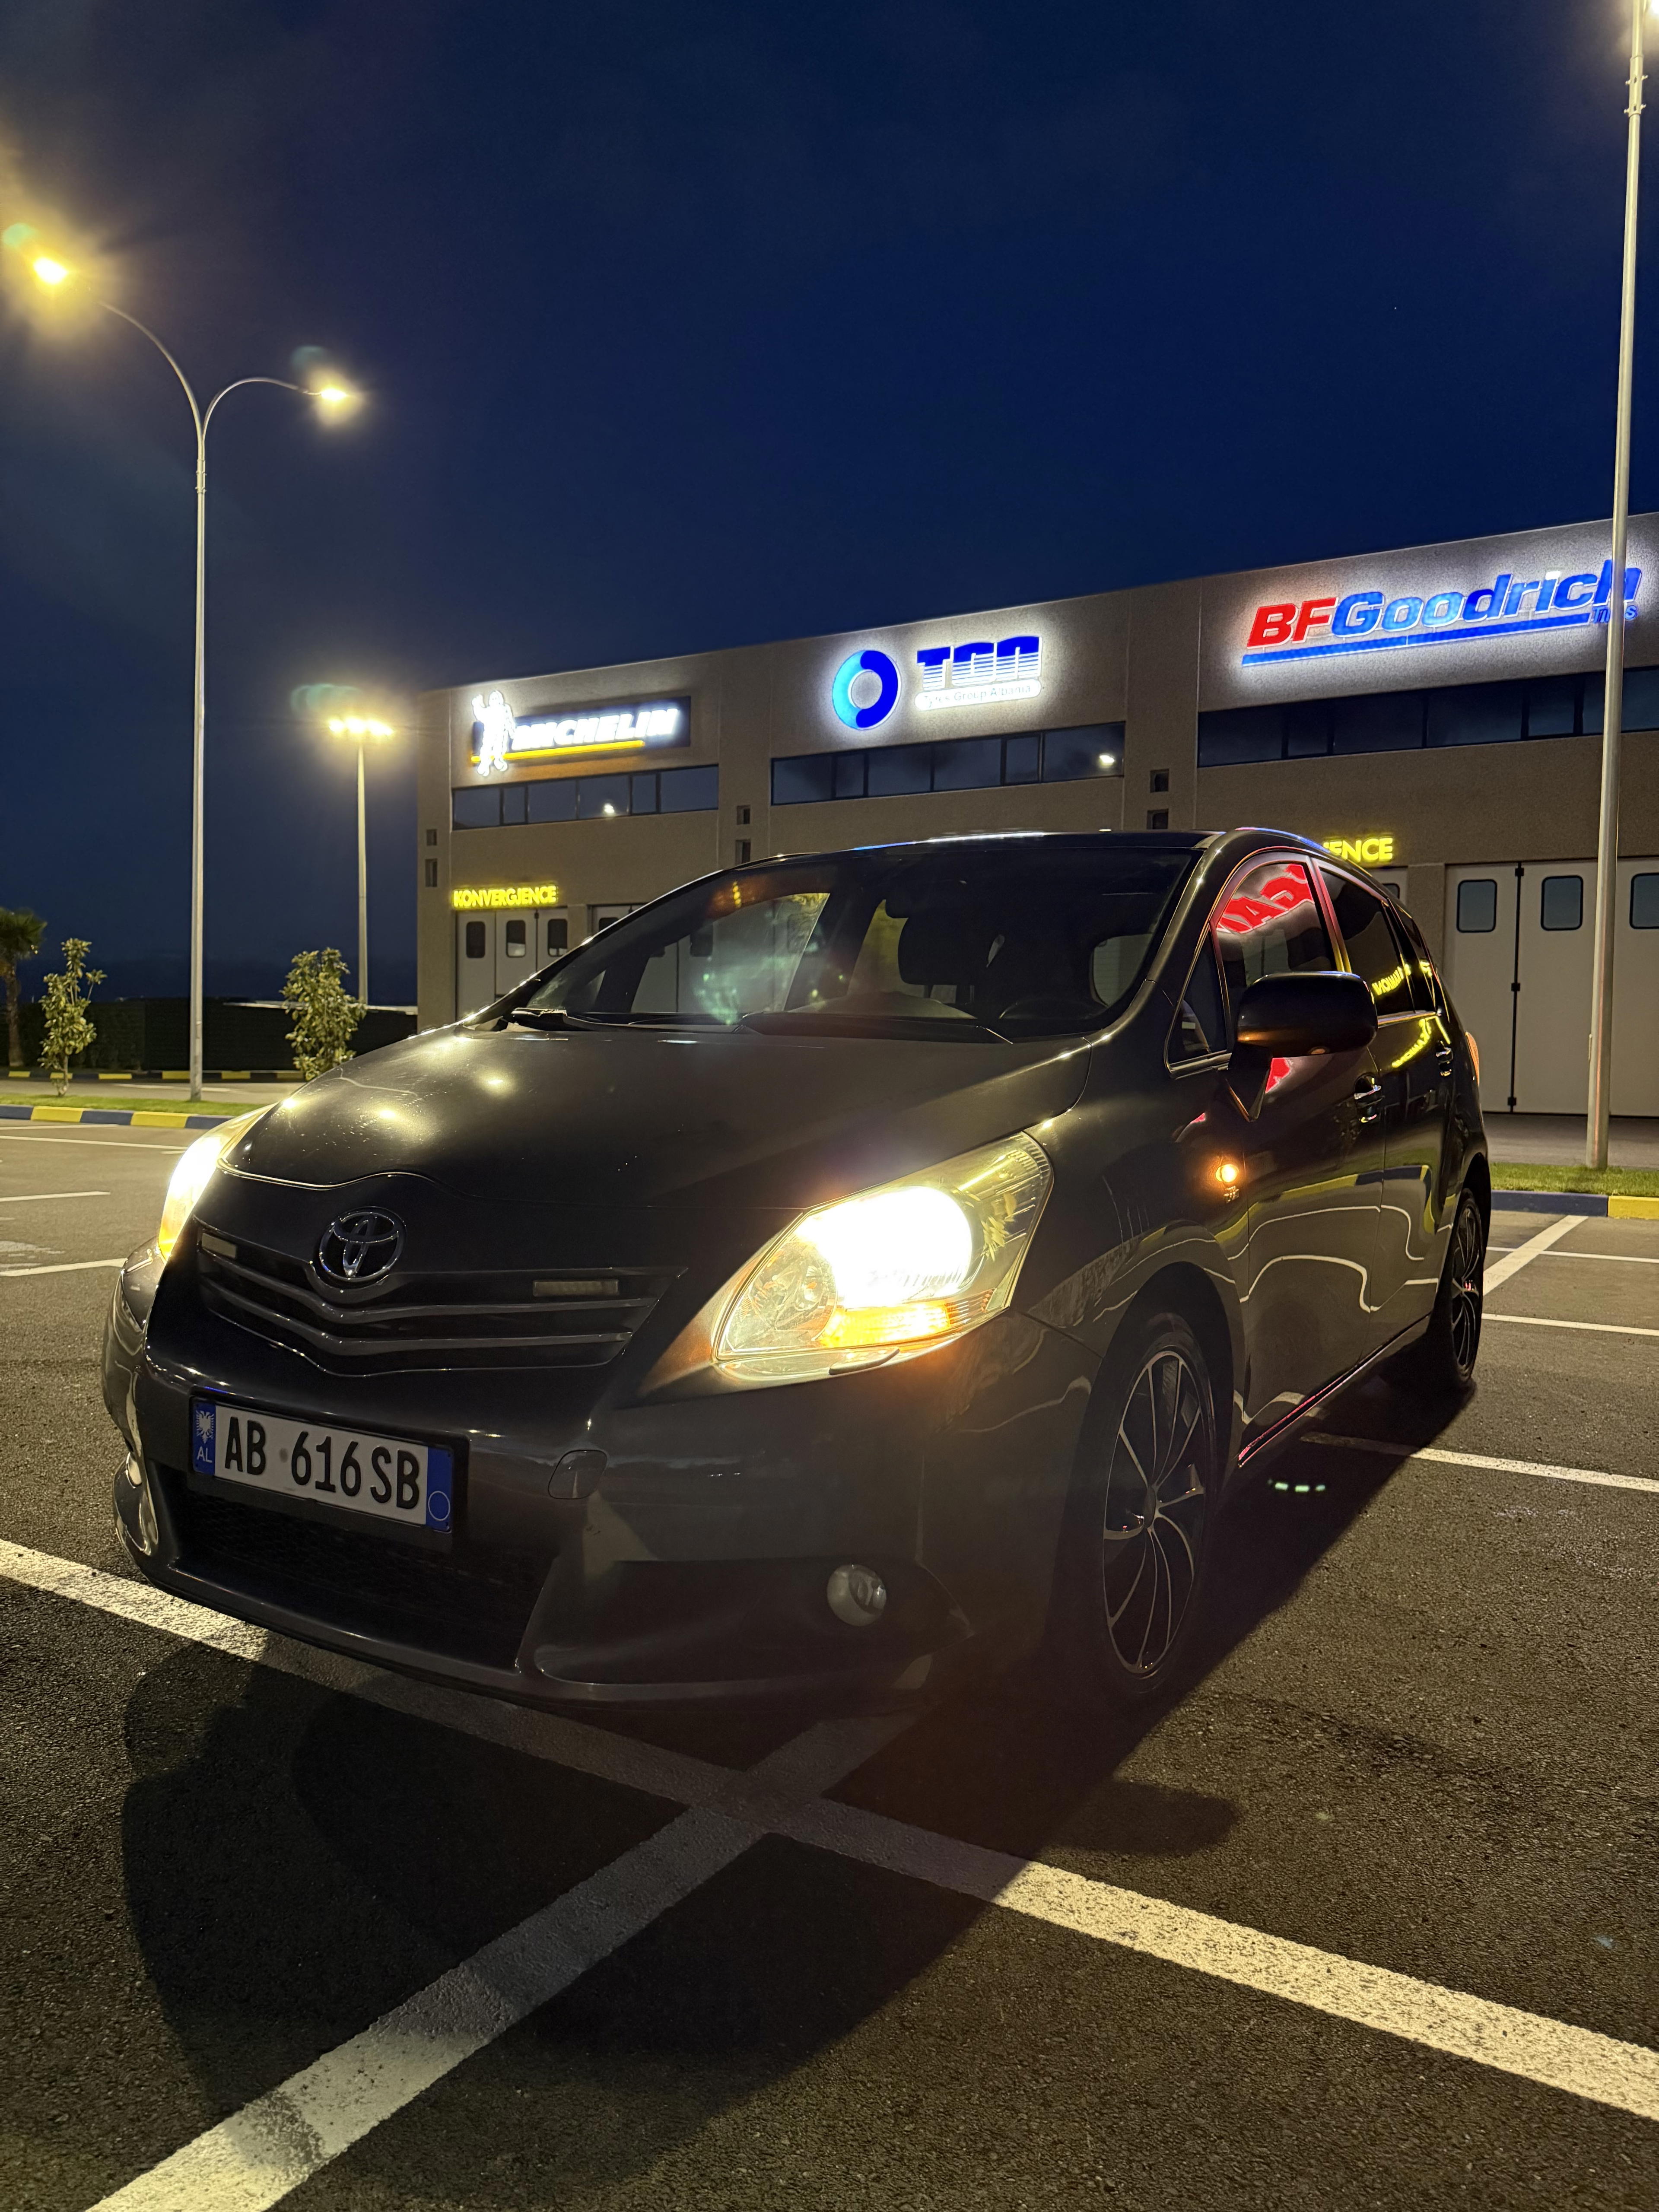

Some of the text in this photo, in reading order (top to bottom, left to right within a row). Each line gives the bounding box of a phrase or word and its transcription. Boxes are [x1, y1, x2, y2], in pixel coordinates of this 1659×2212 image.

[1246, 559, 1642, 648] BFGoodrich
[1592, 605, 1638, 623] Tis
[953, 691, 987, 702] Group
[990, 686, 1031, 697] Albania
[511, 708, 679, 750] MICHELIN
[1323, 837, 1393, 863] ENCE
[453, 885, 557, 907] KONVERGJENCE
[197, 1446, 213, 1463] AL
[224, 1416, 267, 1475] AB
